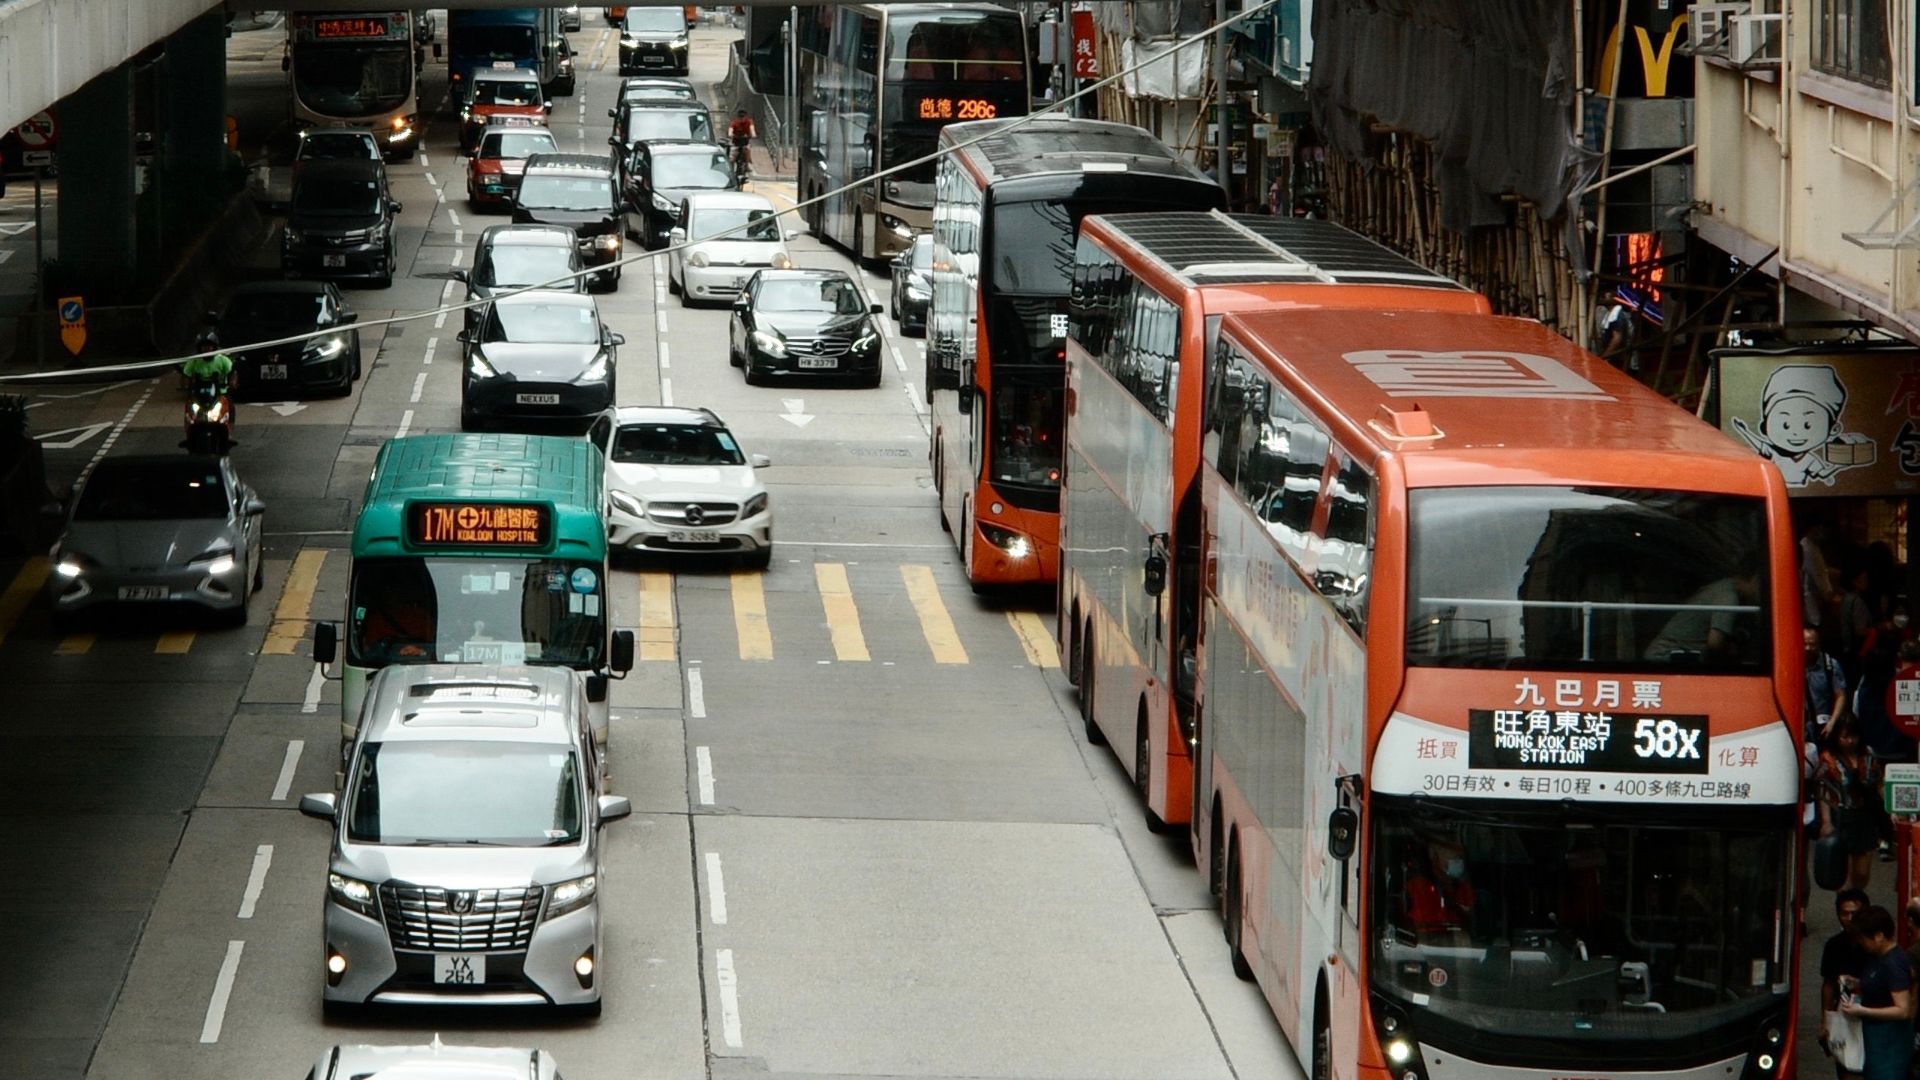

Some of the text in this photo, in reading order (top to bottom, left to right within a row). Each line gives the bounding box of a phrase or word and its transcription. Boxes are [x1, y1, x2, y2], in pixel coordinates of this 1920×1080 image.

[424, 508, 538, 541] 17M 九龍醫院
[457, 530, 538, 542] KOWLOON HOSPITAL
[468, 647, 498, 660] 17M
[1514, 677, 1662, 708] 九巴月票
[1494, 709, 1612, 738] 旺角東站
[1495, 735, 1607, 751] MONG KOK EAST
[1520, 750, 1585, 764] STATION
[451, 957, 470, 970] YX
[445, 970, 474, 984] 264
